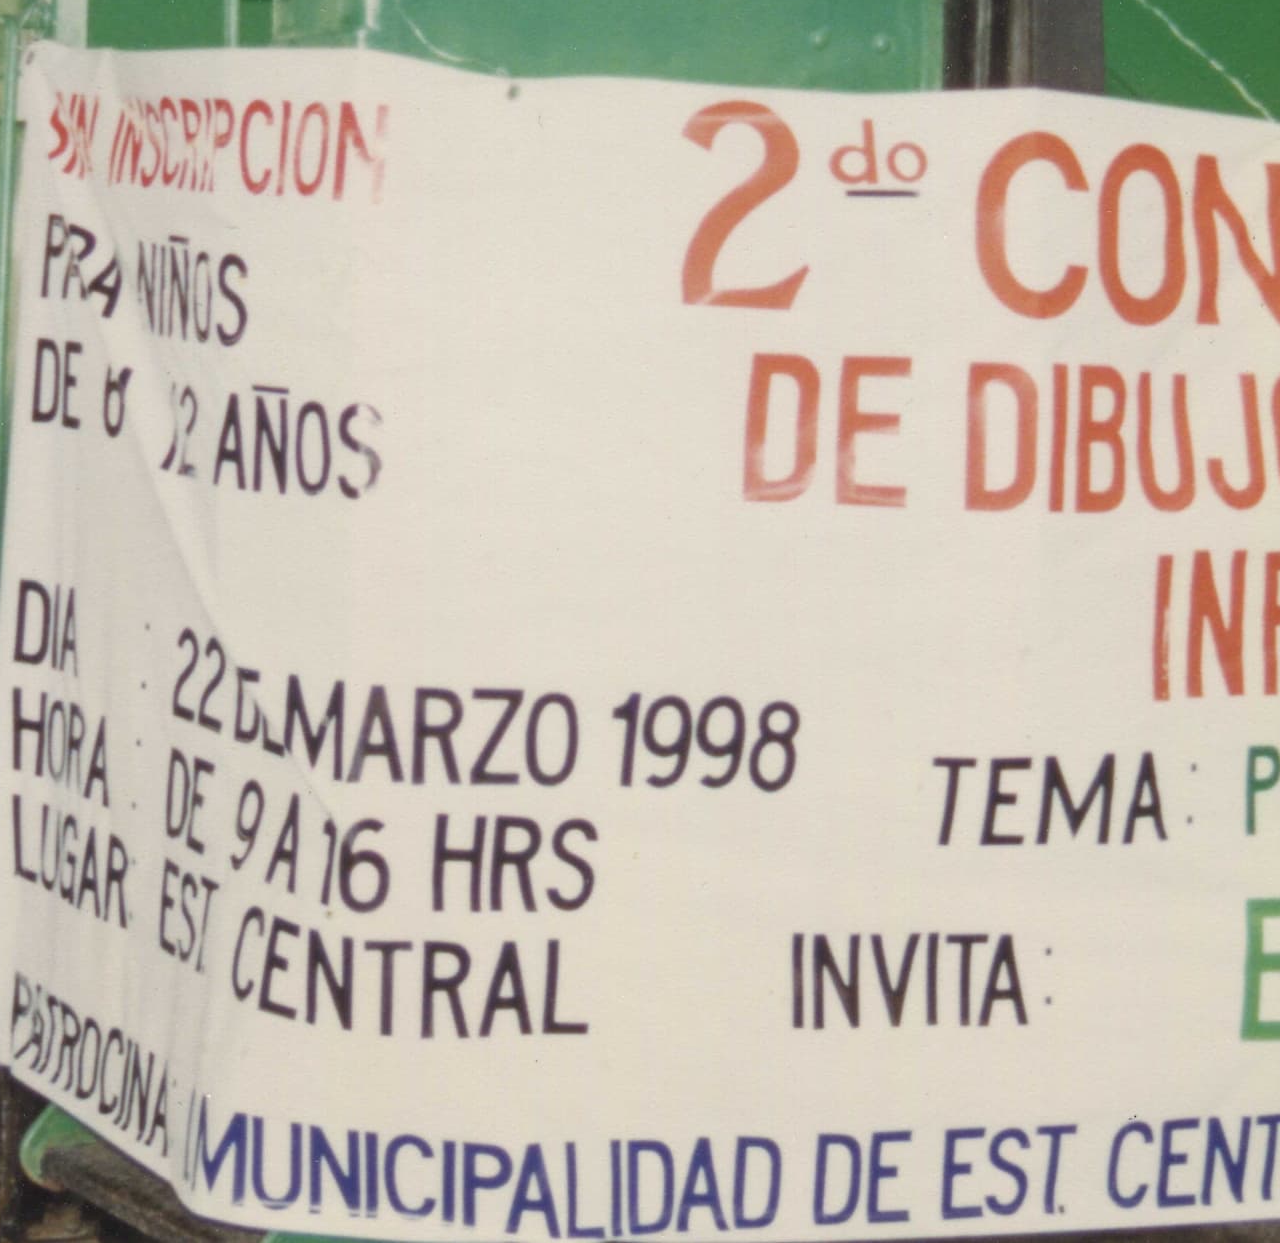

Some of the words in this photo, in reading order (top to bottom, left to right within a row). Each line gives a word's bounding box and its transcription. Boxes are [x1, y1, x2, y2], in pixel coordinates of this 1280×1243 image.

[137, 235, 247, 347] NIÑOS
[32, 337, 83, 430] DE
[213, 384, 384, 501] AÑOS
[742, 353, 913, 508] DE
[12, 579, 78, 677] DIA
[172, 627, 226, 734] 22
[283, 672, 580, 787] MARZO
[612, 694, 802, 793] 1998
[166, 746, 215, 856] DE
[230, 779, 264, 870] 9
[264, 792, 300, 894] A
[320, 817, 391, 914] 16
[431, 814, 600, 913] HRS
[232, 906, 590, 1040] CENTRAL
[191, 1094, 783, 1239] MUNICIPALIDAD
[812, 1130, 913, 1226] DE
